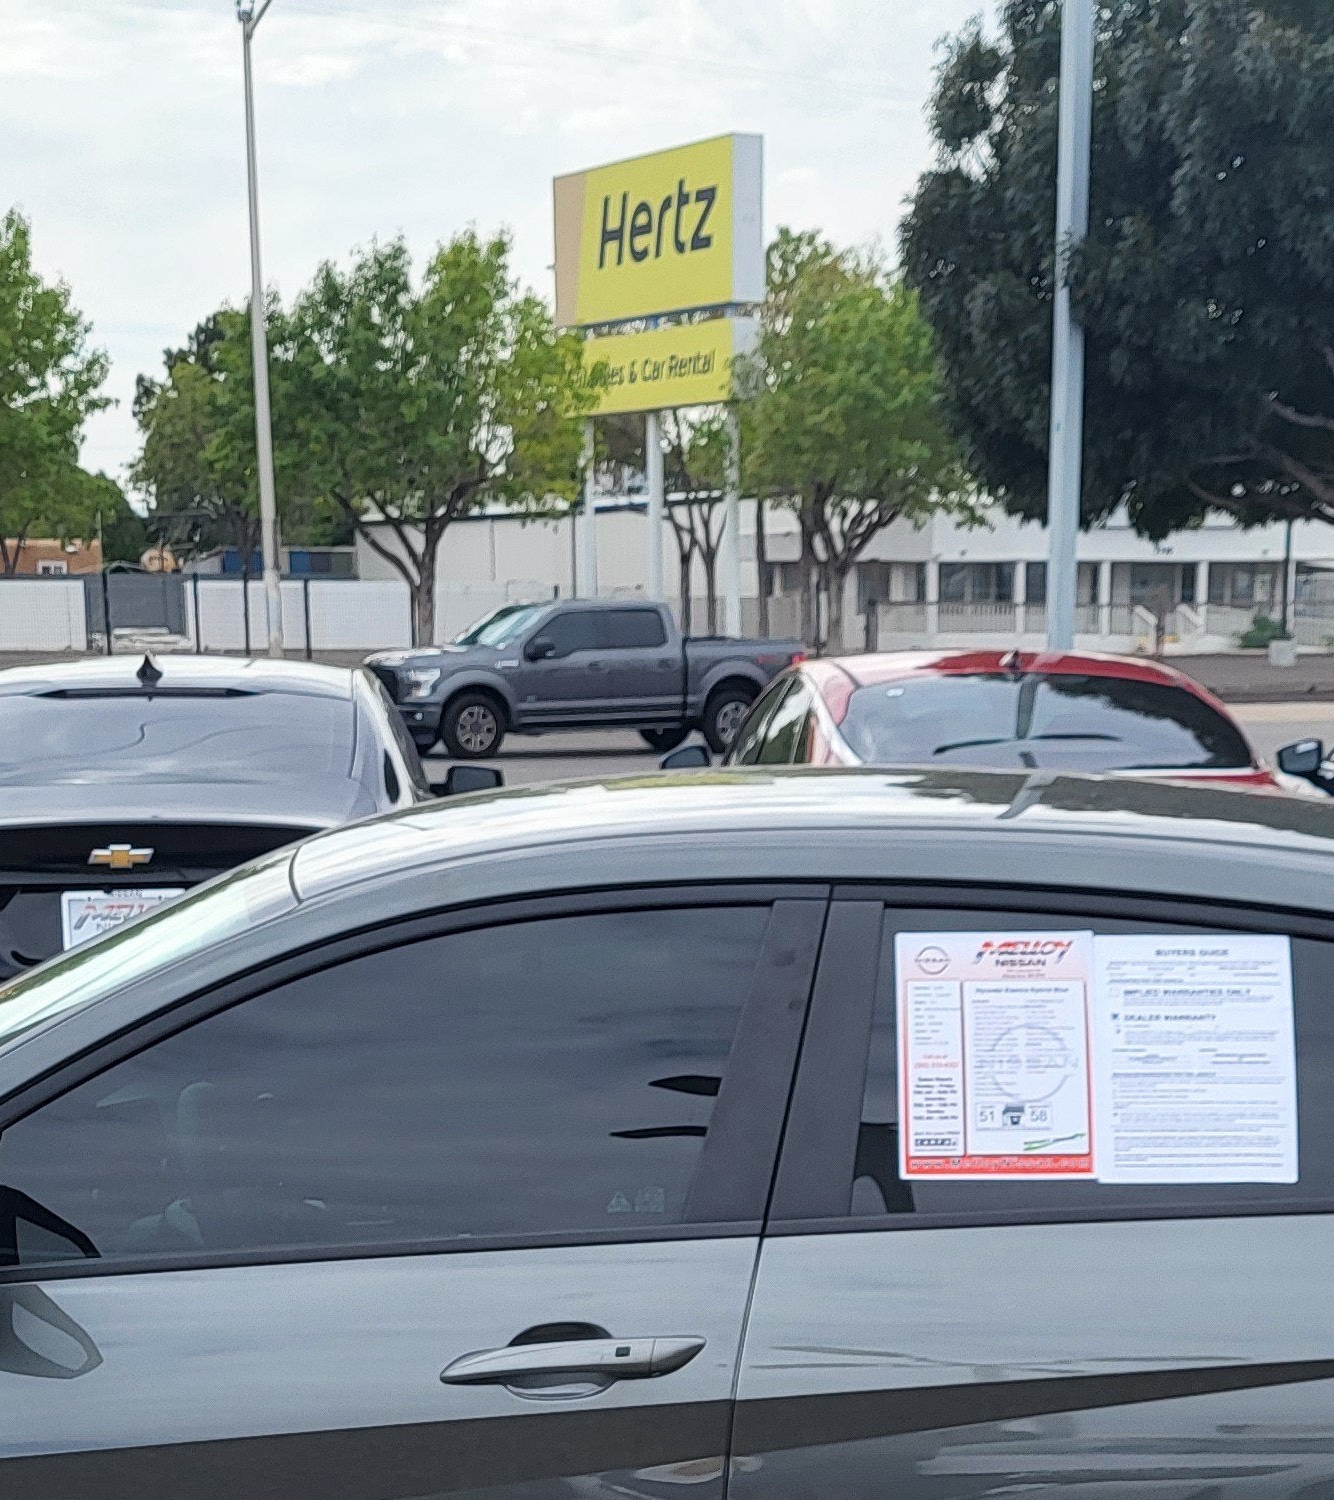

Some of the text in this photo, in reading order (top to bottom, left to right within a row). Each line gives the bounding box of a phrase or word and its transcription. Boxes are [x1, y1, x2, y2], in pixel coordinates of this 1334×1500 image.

[598, 178, 718, 269] Hertz
[628, 359, 638, 383] &
[641, 358, 666, 382] Car
[667, 348, 717, 379] Rental
[979, 1111, 995, 1123] 51
